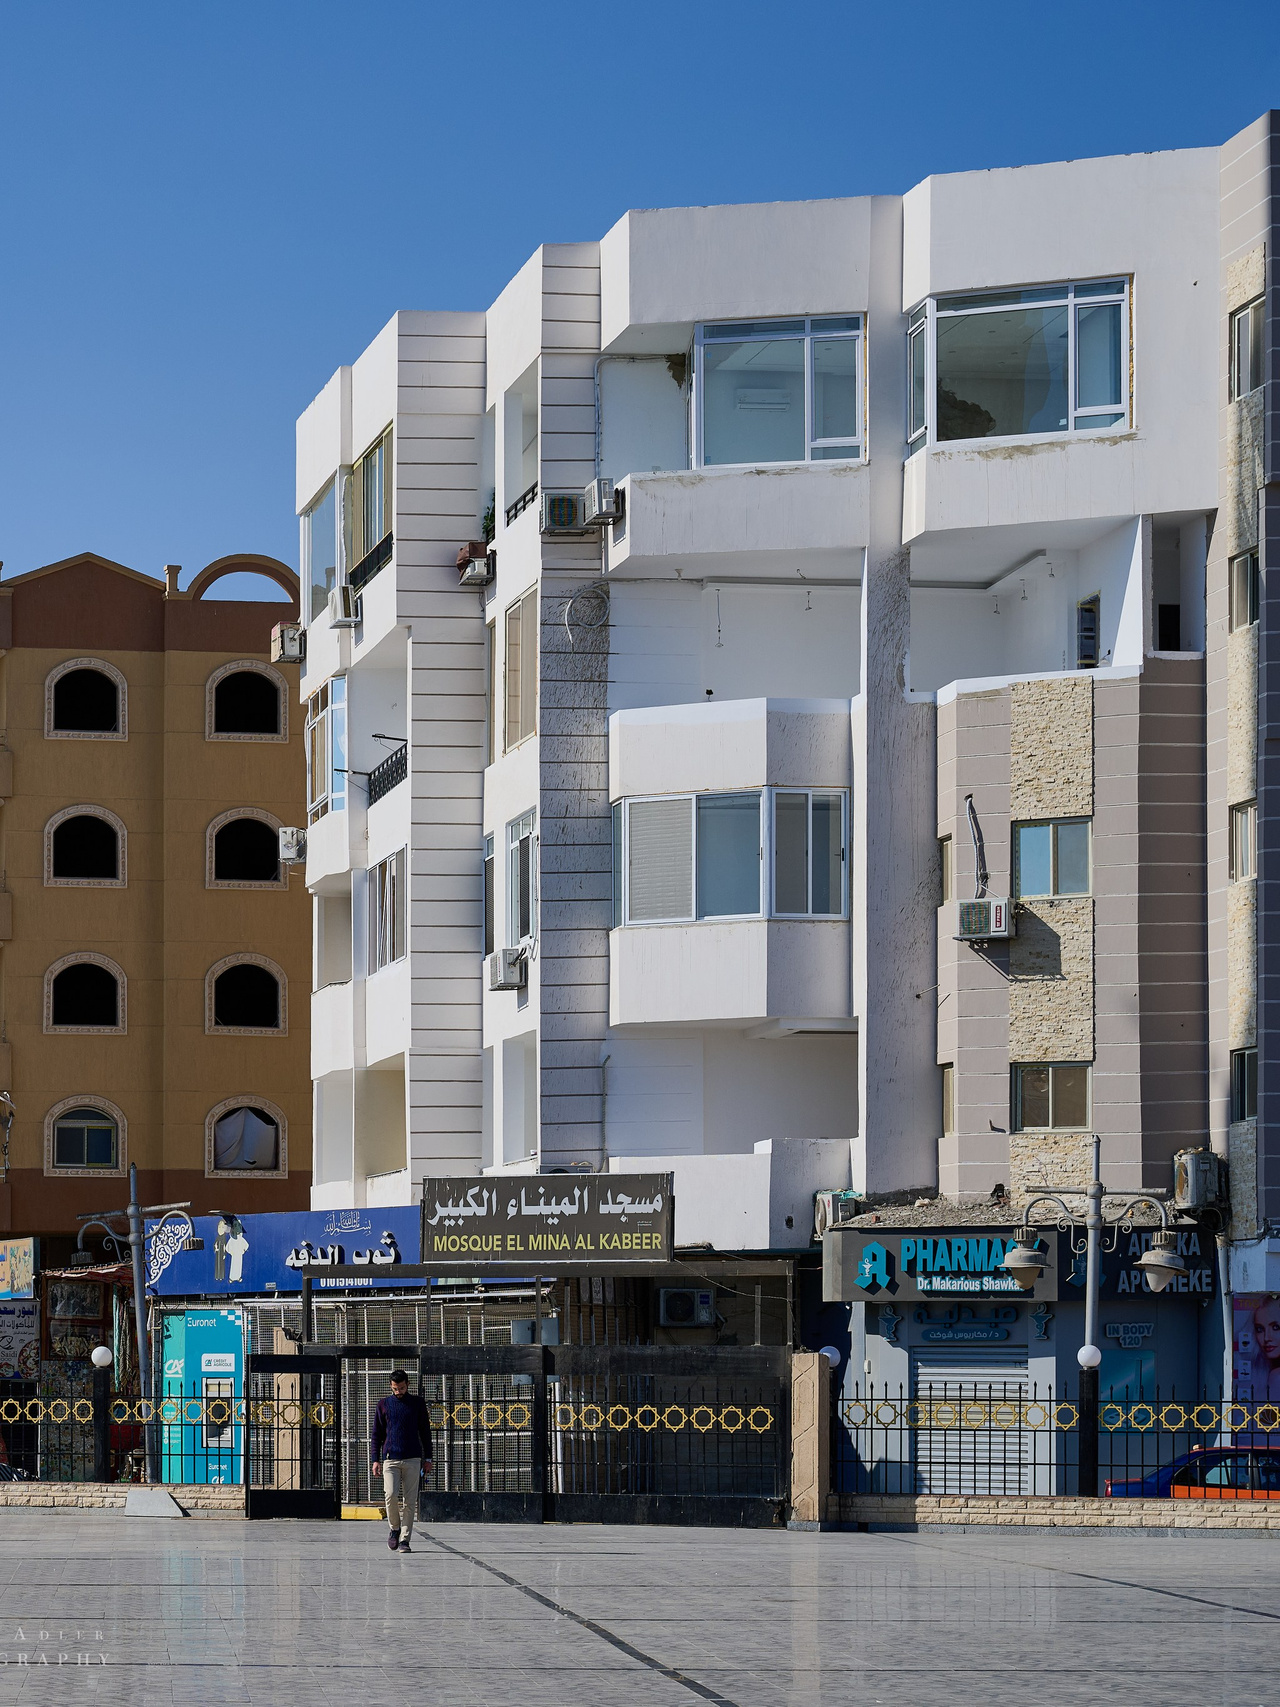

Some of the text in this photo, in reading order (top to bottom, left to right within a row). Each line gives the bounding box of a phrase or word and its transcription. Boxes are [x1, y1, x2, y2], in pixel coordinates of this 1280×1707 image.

[427, 1185, 663, 1227] مسجد الميناء الكبير
[433, 1233, 662, 1252] MOSQUE EL MINA AL KABEER
[1128, 1232, 1201, 1256] АПКА
[901, 1238, 1041, 1272] PHARMA
[917, 1276, 1024, 1291] Dr. Makarious Shawka
[1118, 1269, 1213, 1293] APOHEKE
[187, 1317, 217, 1327] Euronet
[913, 1303, 1019, 1329] صيدلية
[1107, 1323, 1153, 1337] IN BODY
[1121, 1336, 1141, 1347] 120
[1, 1350, 18, 1358] Saidi
